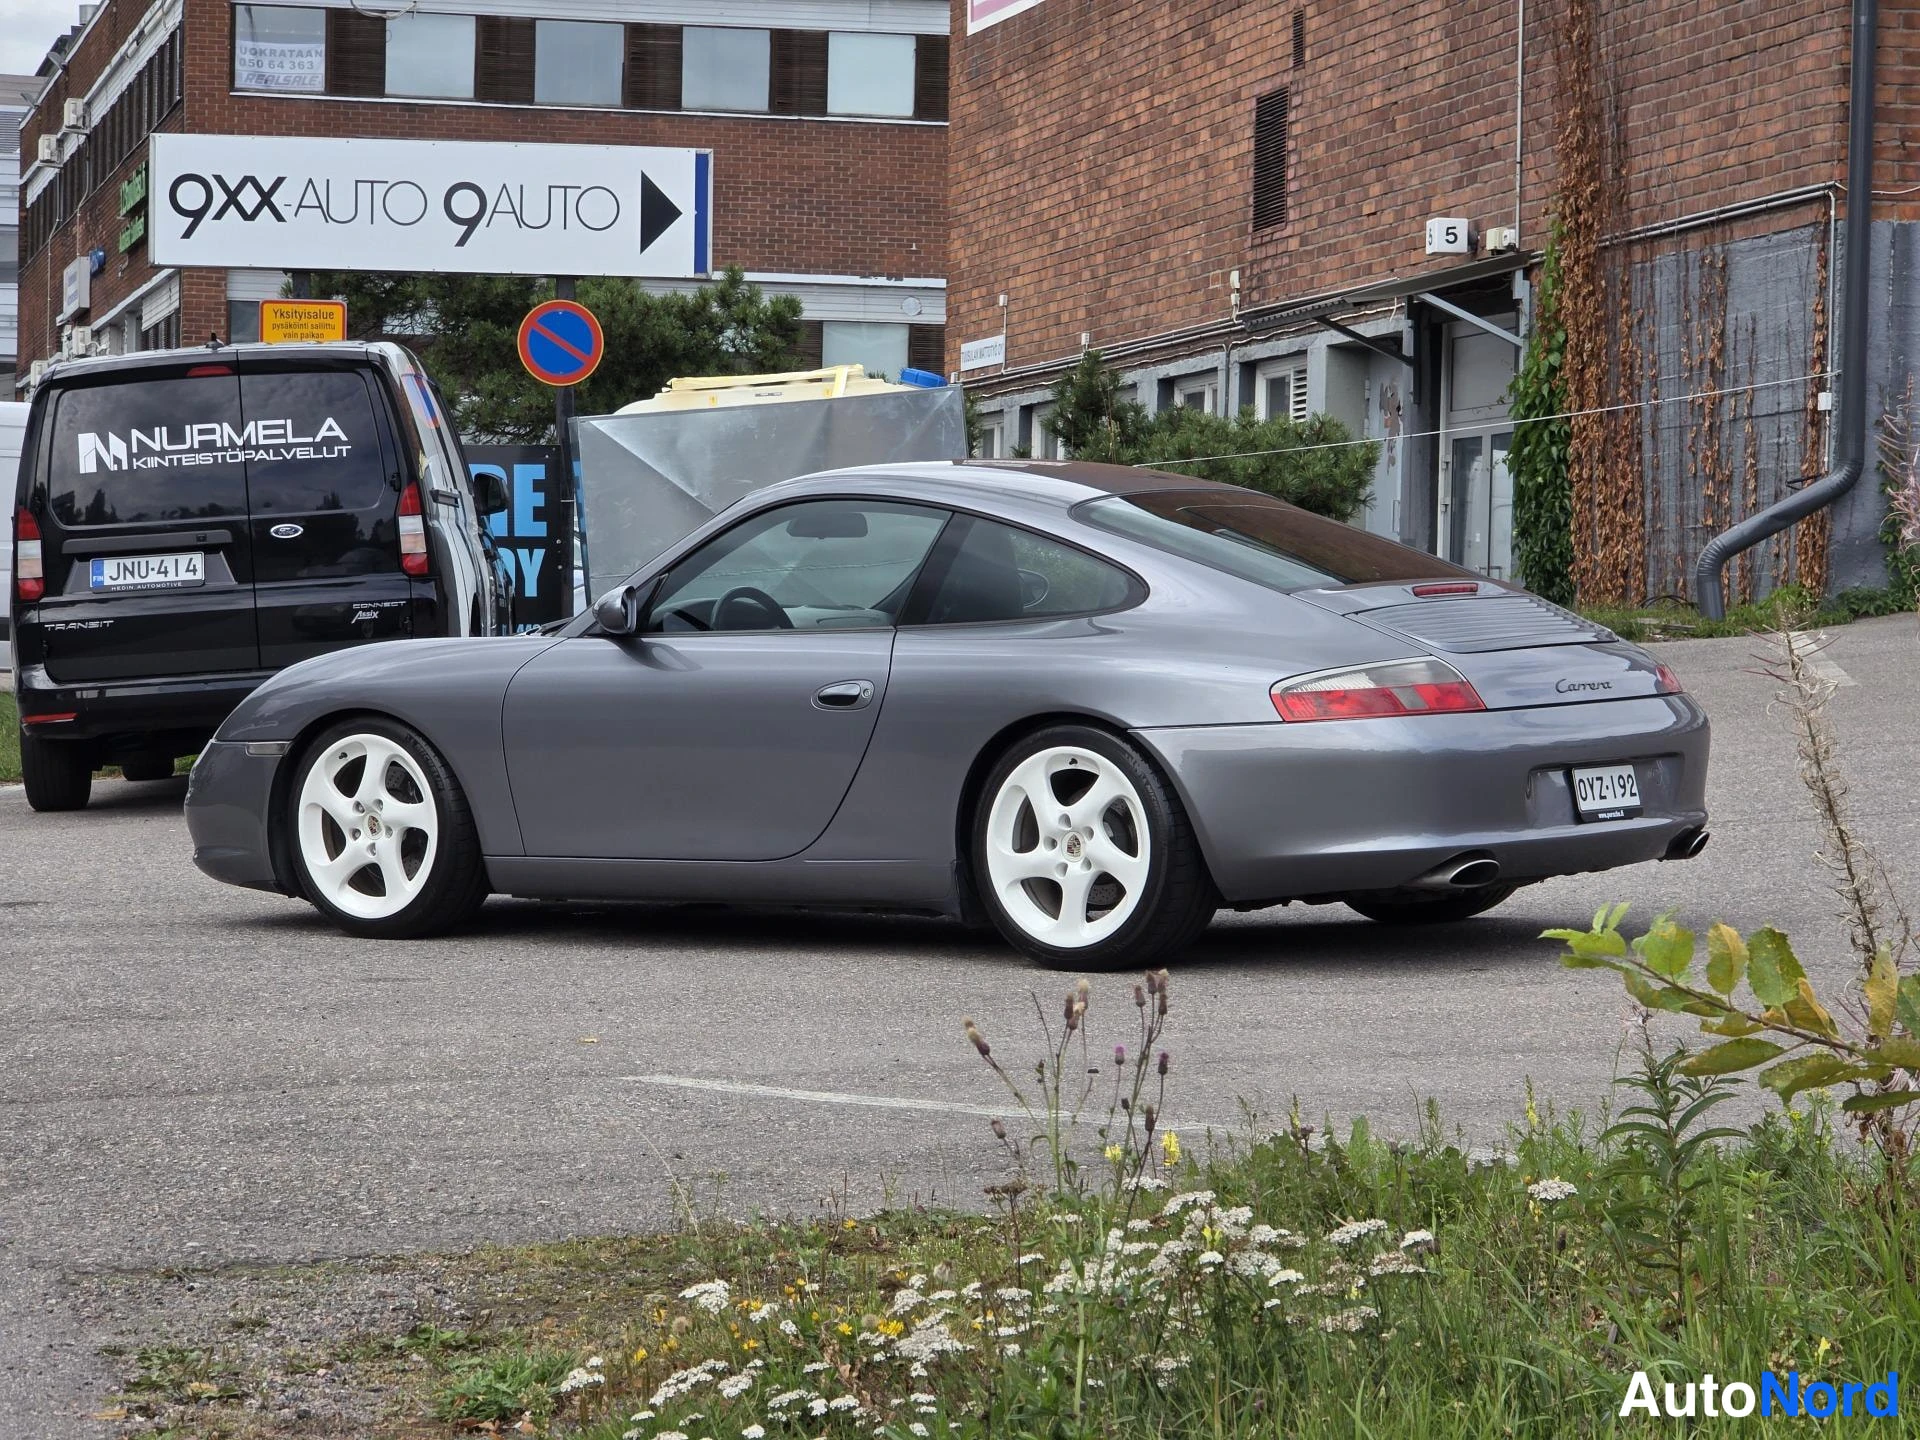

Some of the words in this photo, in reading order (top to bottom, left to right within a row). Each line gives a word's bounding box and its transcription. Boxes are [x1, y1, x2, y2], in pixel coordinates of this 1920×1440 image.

[1444, 225, 1458, 245] 5
[272, 308, 335, 321] Yksityisalue
[271, 321, 309, 331] pysäköinti
[310, 322, 336, 330] sallittu
[283, 331, 299, 340] vain
[300, 331, 325, 342] paikan
[131, 417, 349, 453] NURMELA
[132, 445, 352, 470] KIINTEISTÖPALVELUT
[137, 581, 183, 590] AUTOMOTIVE
[352, 600, 407, 609] CONNECT
[44, 620, 115, 631] TRANSIT
[1555, 678, 1613, 693] Carrera
